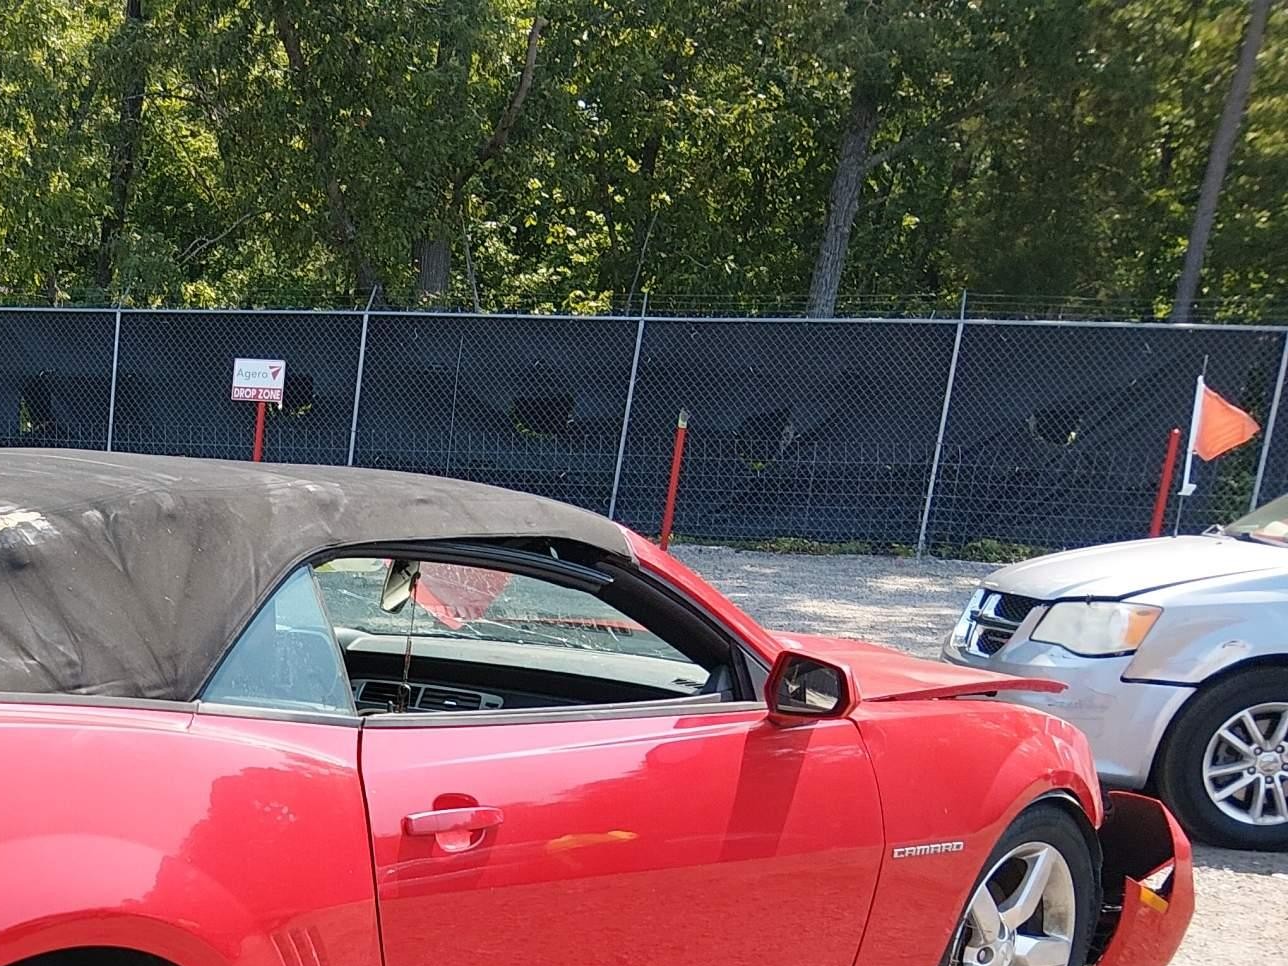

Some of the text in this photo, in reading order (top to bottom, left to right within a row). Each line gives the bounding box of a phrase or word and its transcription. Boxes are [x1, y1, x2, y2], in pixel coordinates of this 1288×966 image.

[236, 368, 268, 380] Agero
[233, 387, 281, 400] DROP ZONE
[892, 841, 964, 858] CAMARO
